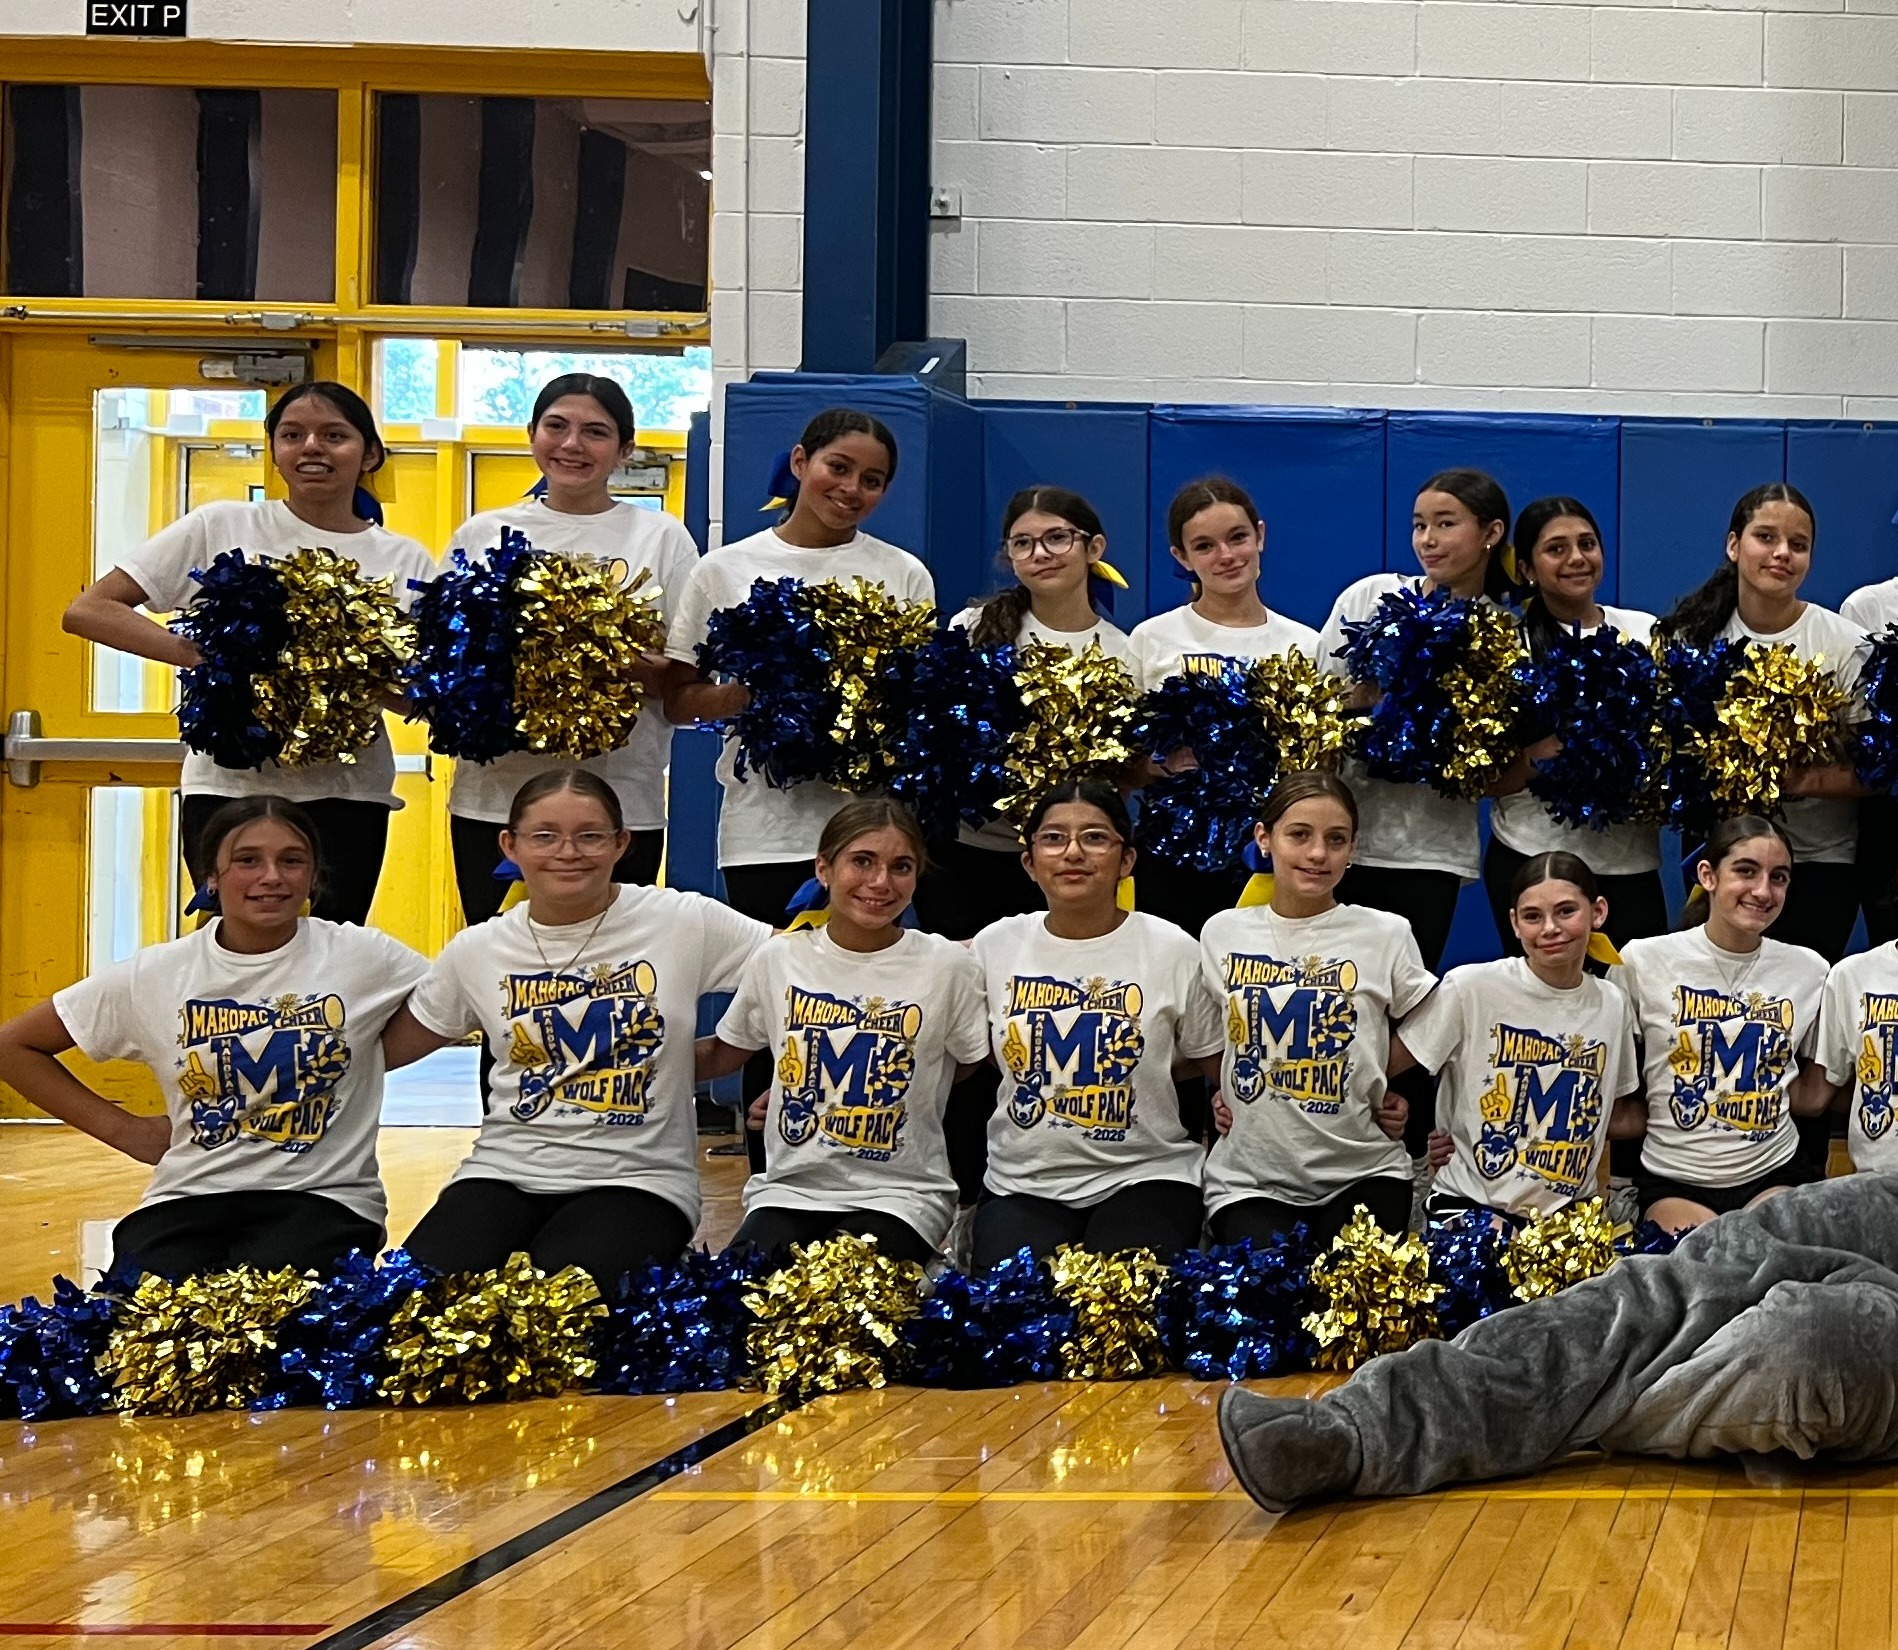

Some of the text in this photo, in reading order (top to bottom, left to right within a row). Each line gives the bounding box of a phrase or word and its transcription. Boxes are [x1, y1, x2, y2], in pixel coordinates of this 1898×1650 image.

[92, 3, 181, 28] EXIT P
[514, 979, 585, 1009] MAHOPAC
[596, 974, 633, 996] CHEER
[1306, 969, 1338, 987] CHEER
[792, 992, 857, 1026] MAHOPAC
[1014, 980, 1080, 1010] MAHOPAC
[1088, 993, 1123, 1010] CHEER
[1683, 990, 1742, 1020] MAHOPAC
[192, 1005, 269, 1039] MAHOPAC
[281, 1007, 322, 1028] CHEER
[864, 1014, 901, 1032] CHEER
[1243, 987, 1321, 1060] M
[533, 999, 616, 1071] M
[1024, 1011, 1104, 1086] M
[1502, 1030, 1562, 1062] MAHOPAC
[210, 1029, 301, 1110] M
[799, 1027, 880, 1107] M
[1698, 1021, 1765, 1092] M
[563, 1070, 644, 1106] WOLF PAC
[1271, 1062, 1339, 1097] WOLF PAC
[291, 1100, 322, 1135] PAC
[606, 1112, 645, 1126] 2026
[1054, 1089, 1126, 1123] WOLF PAC
[1306, 1101, 1340, 1115] 2026
[1505, 1064, 1581, 1142] M
[1716, 1099, 1753, 1122] WOLF
[825, 1110, 894, 1145] WOLF PAC
[1093, 1129, 1126, 1142] 2026
[857, 1149, 891, 1162] 2026
[1525, 1145, 1589, 1182] WOLF PAC
